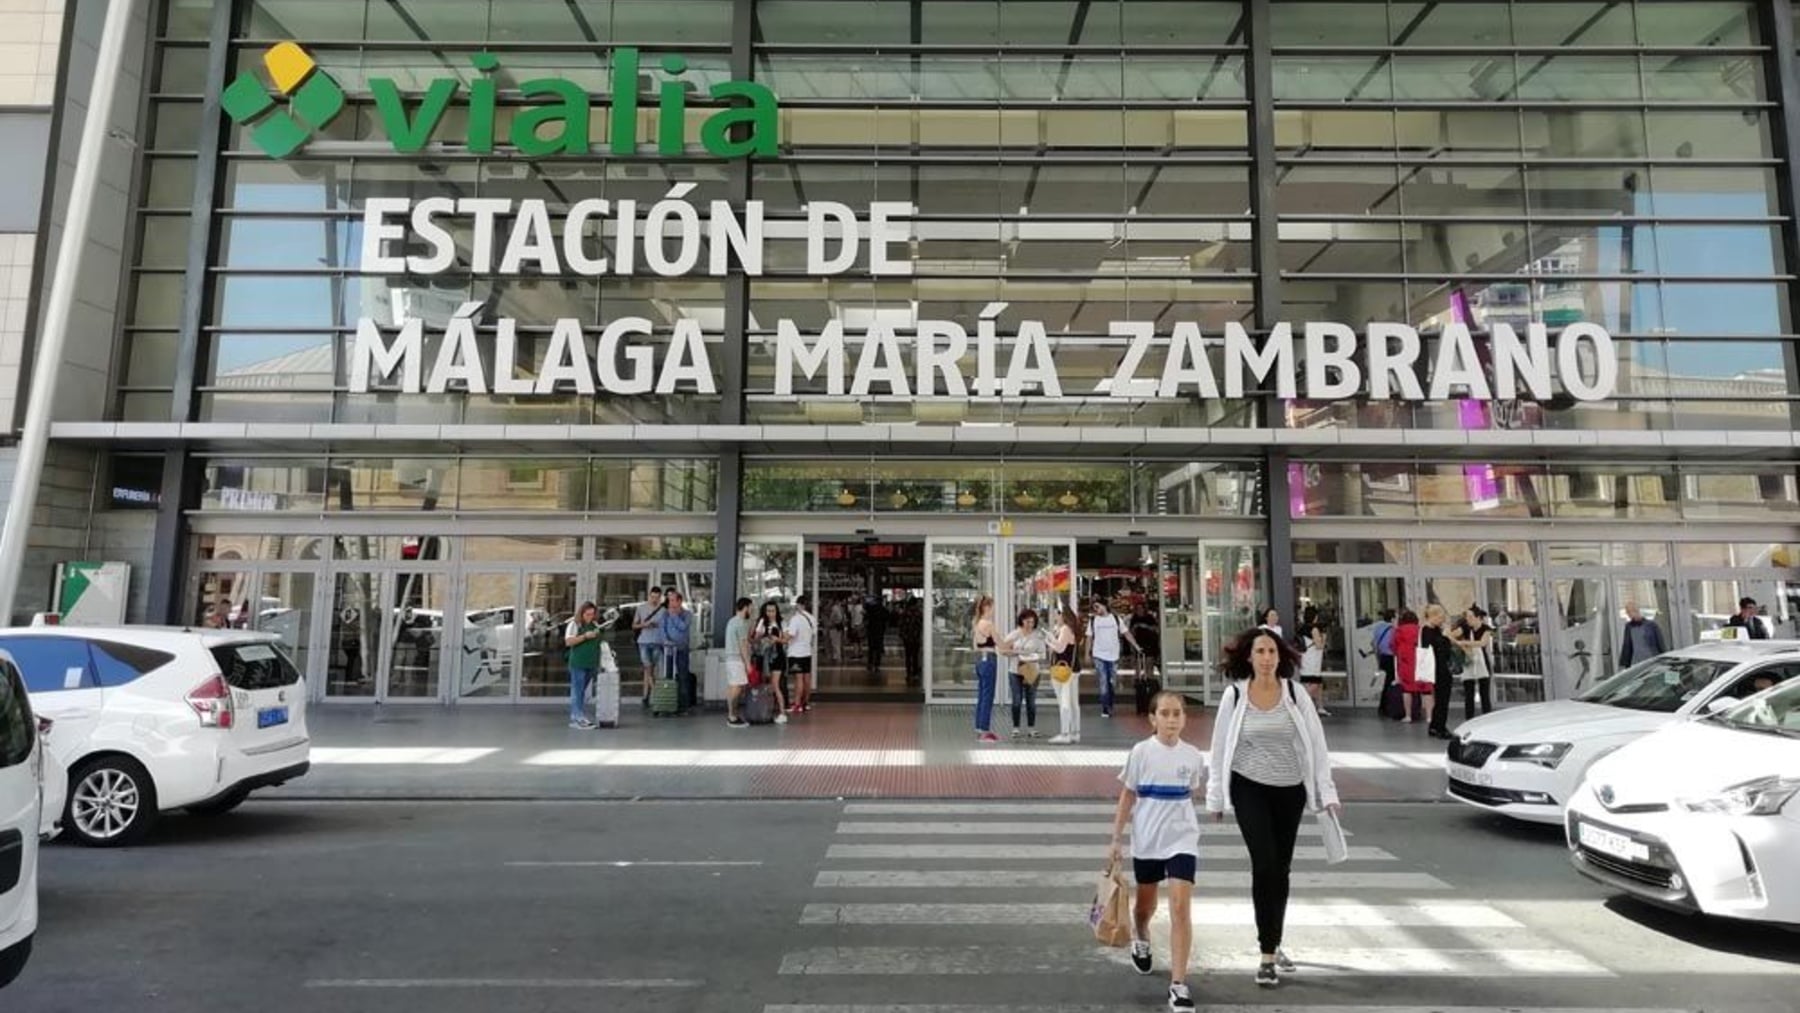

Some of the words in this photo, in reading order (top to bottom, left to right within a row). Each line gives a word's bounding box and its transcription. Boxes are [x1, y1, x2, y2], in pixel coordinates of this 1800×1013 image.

[368, 47, 781, 158] vialia
[361, 183, 764, 277] ESTACIÓN
[807, 200, 914, 276] DE
[349, 301, 717, 396] MÁLAGA
[774, 302, 1062, 398] MARÍA
[1107, 320, 1619, 402] ZAMBRANO
